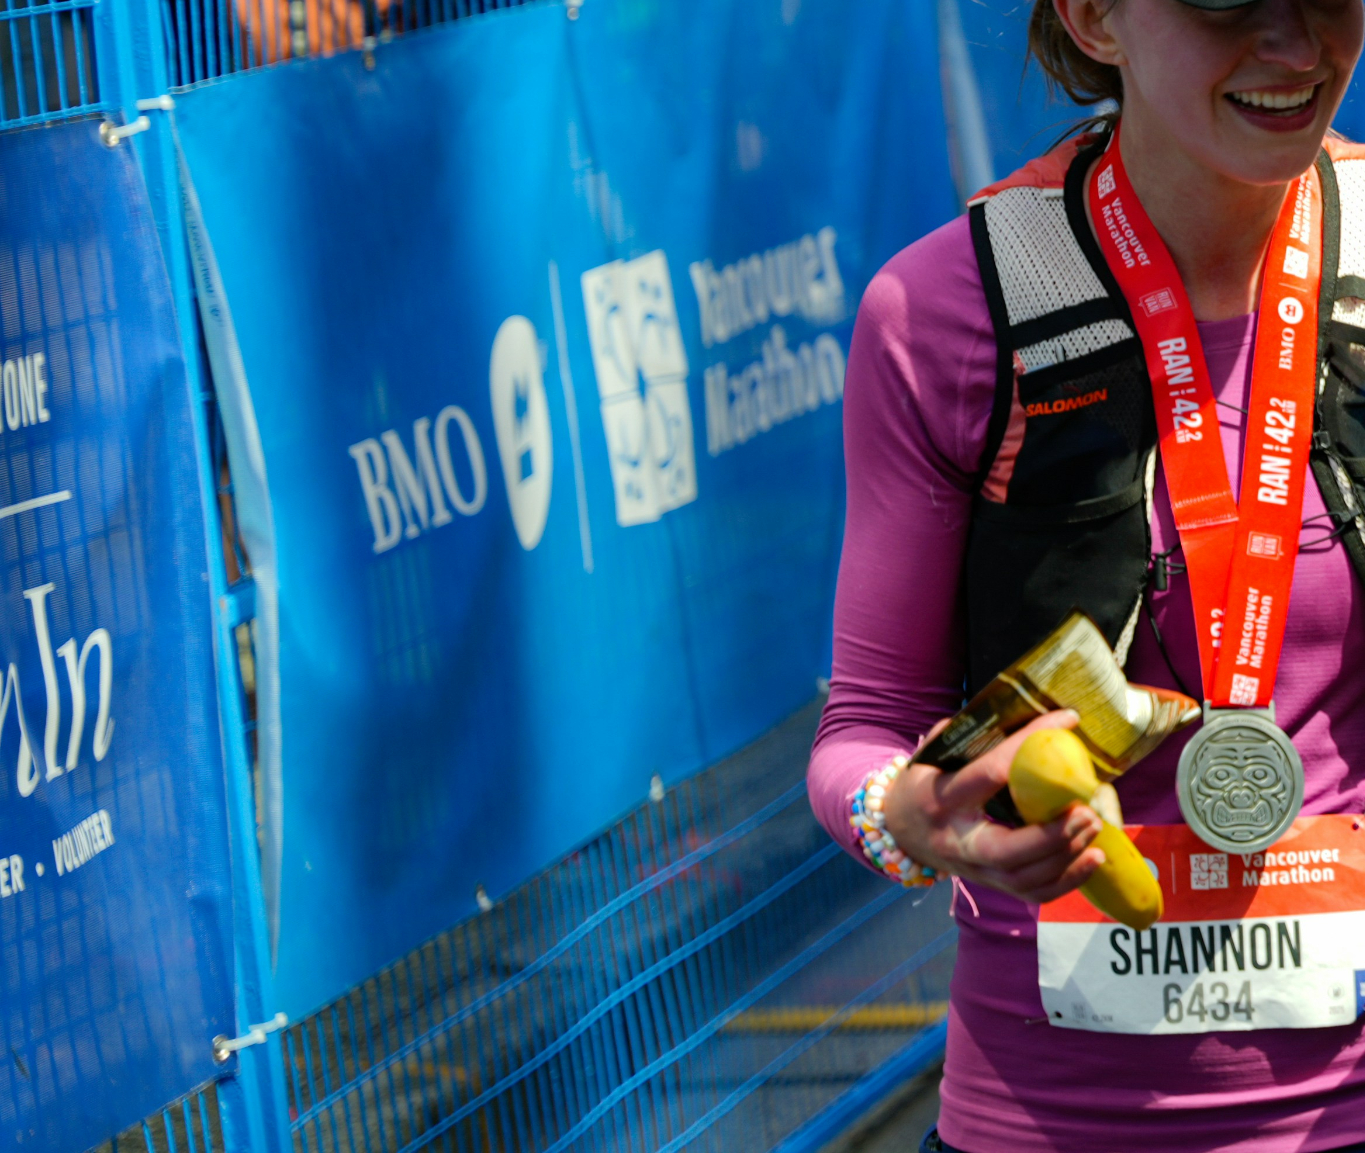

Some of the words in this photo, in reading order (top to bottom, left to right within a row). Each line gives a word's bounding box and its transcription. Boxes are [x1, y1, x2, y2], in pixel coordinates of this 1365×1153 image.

[1101, 204, 1136, 269] Marathon
[1112, 196, 1150, 268] Vancouver
[1278, 327, 1297, 371] BMO
[0, 352, 50, 434] ONE
[703, 323, 847, 458] Marathon
[1026, 388, 1108, 417] SALOMON
[349, 404, 489, 555] BMO
[1235, 586, 1260, 666] Vancouver
[1249, 595, 1273, 670] Marathon
[52, 809, 116, 877] VOLUNTEER
[1242, 848, 1340, 869] Vancouver
[1242, 865, 1335, 888] Marathon
[1109, 920, 1302, 977] SHANNON
[1162, 979, 1255, 1025] 6434
